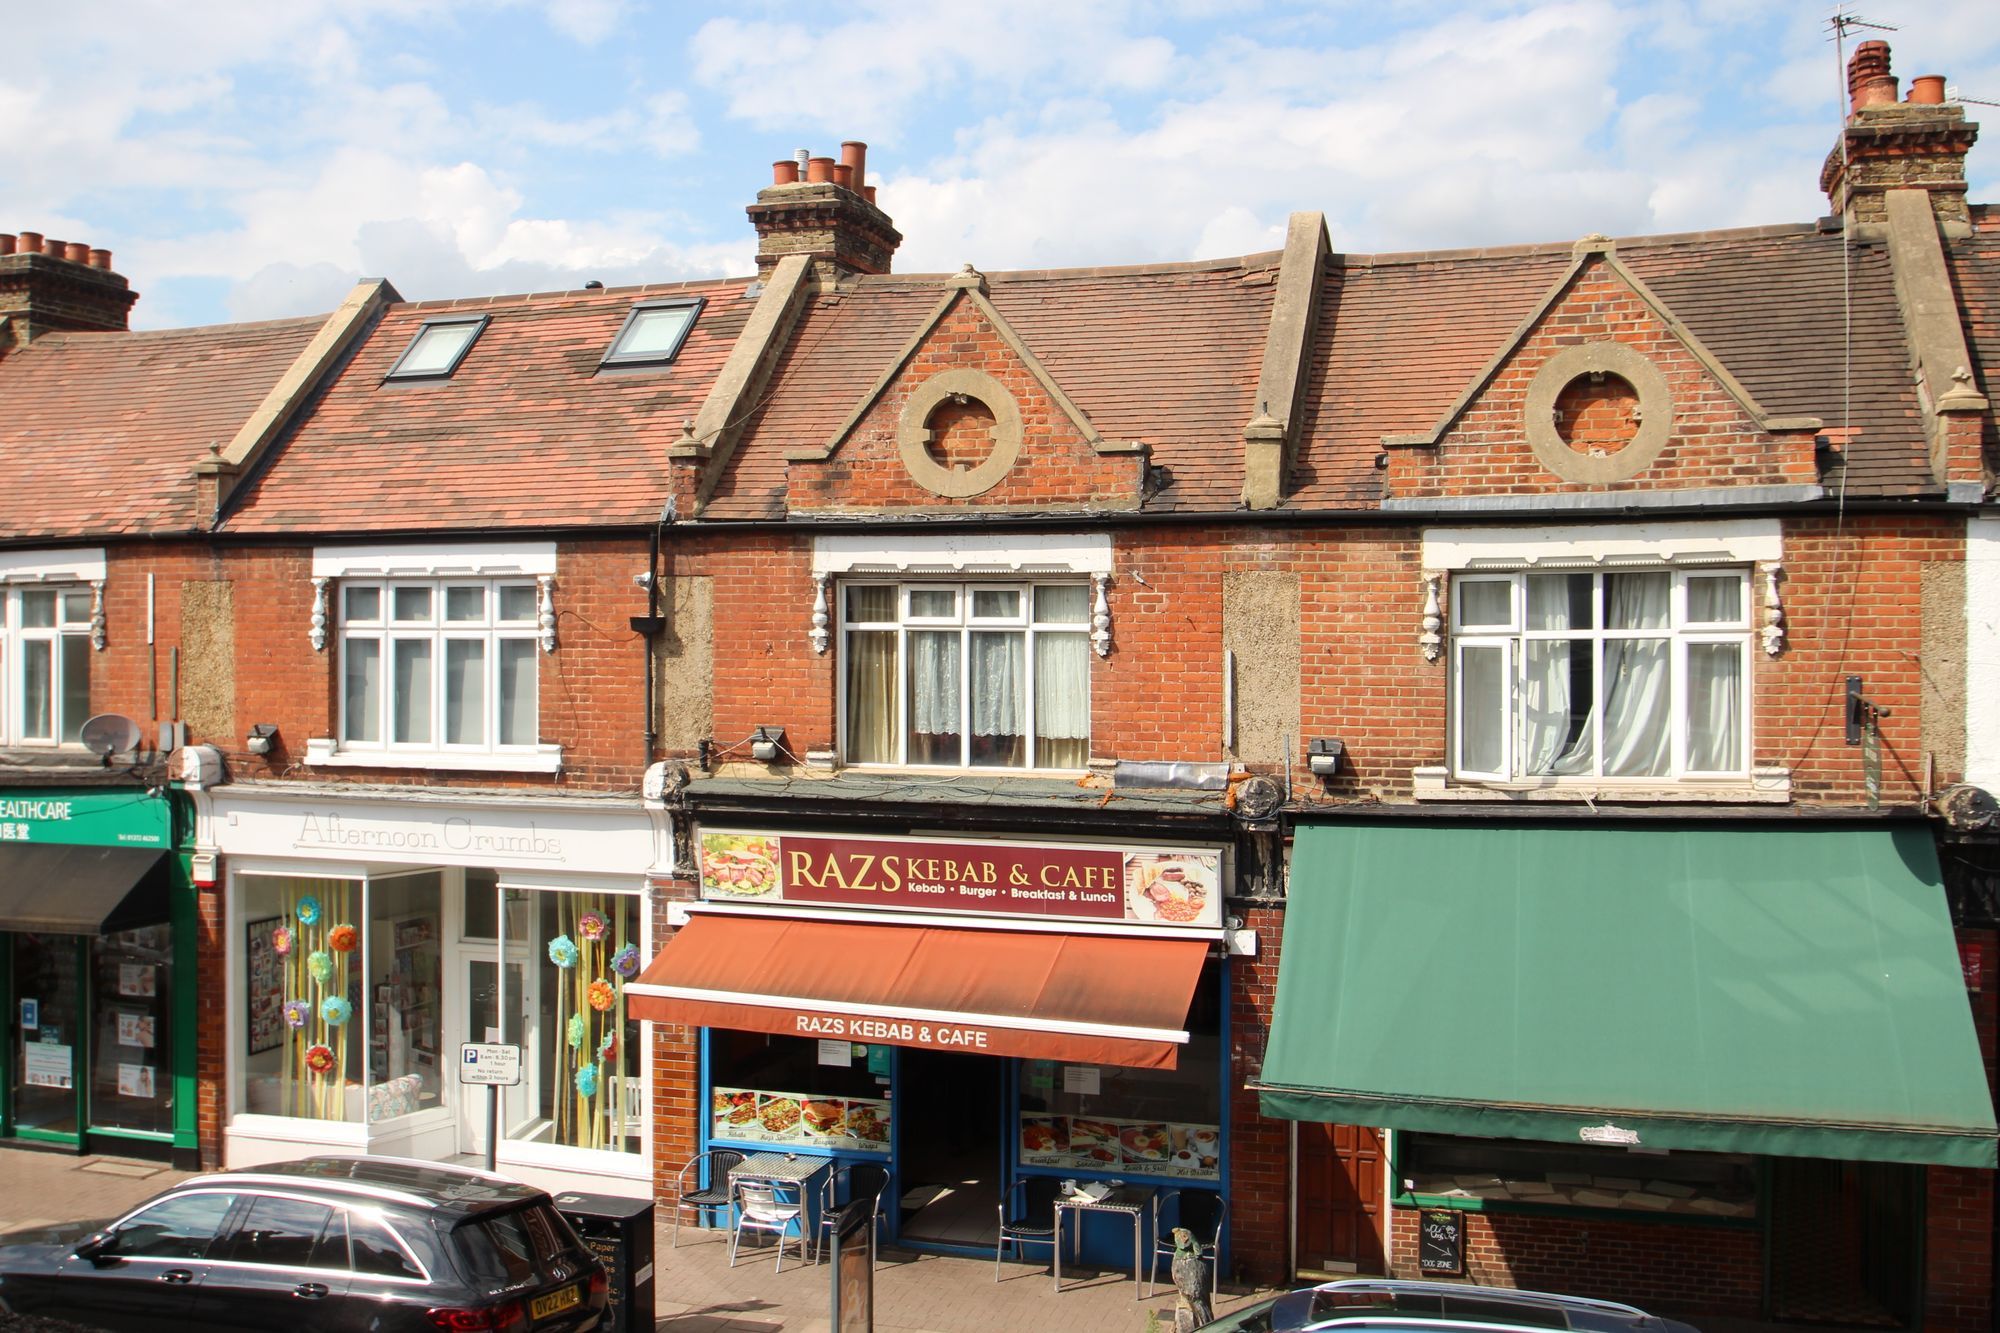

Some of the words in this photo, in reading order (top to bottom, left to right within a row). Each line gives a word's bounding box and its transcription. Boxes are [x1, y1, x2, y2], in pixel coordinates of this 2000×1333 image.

[0, 800, 72, 820] EALTHCARE
[0, 822, 30, 840] 医堂
[297, 811, 440, 848] Afternoon
[444, 816, 562, 855] Crumbs
[788, 850, 901, 892] RAZS
[905, 857, 998, 884] KEBAB
[1009, 863, 1032, 887] &
[1040, 864, 1116, 889] CAFE
[908, 882, 945, 894] Kebab
[959, 885, 997, 897] Burger
[1011, 888, 1066, 901] Breakfast
[1069, 890, 1077, 901] &
[1080, 891, 1116, 903] Lunch
[796, 1015, 845, 1034] RAZS
[850, 1020, 914, 1040] KEBAB
[918, 1028, 932, 1043] &
[937, 1028, 988, 1048] CAFE
[466, 1050, 477, 1063] P
[590, 1241, 616, 1252] Paper
[598, 1254, 614, 1262] ans
